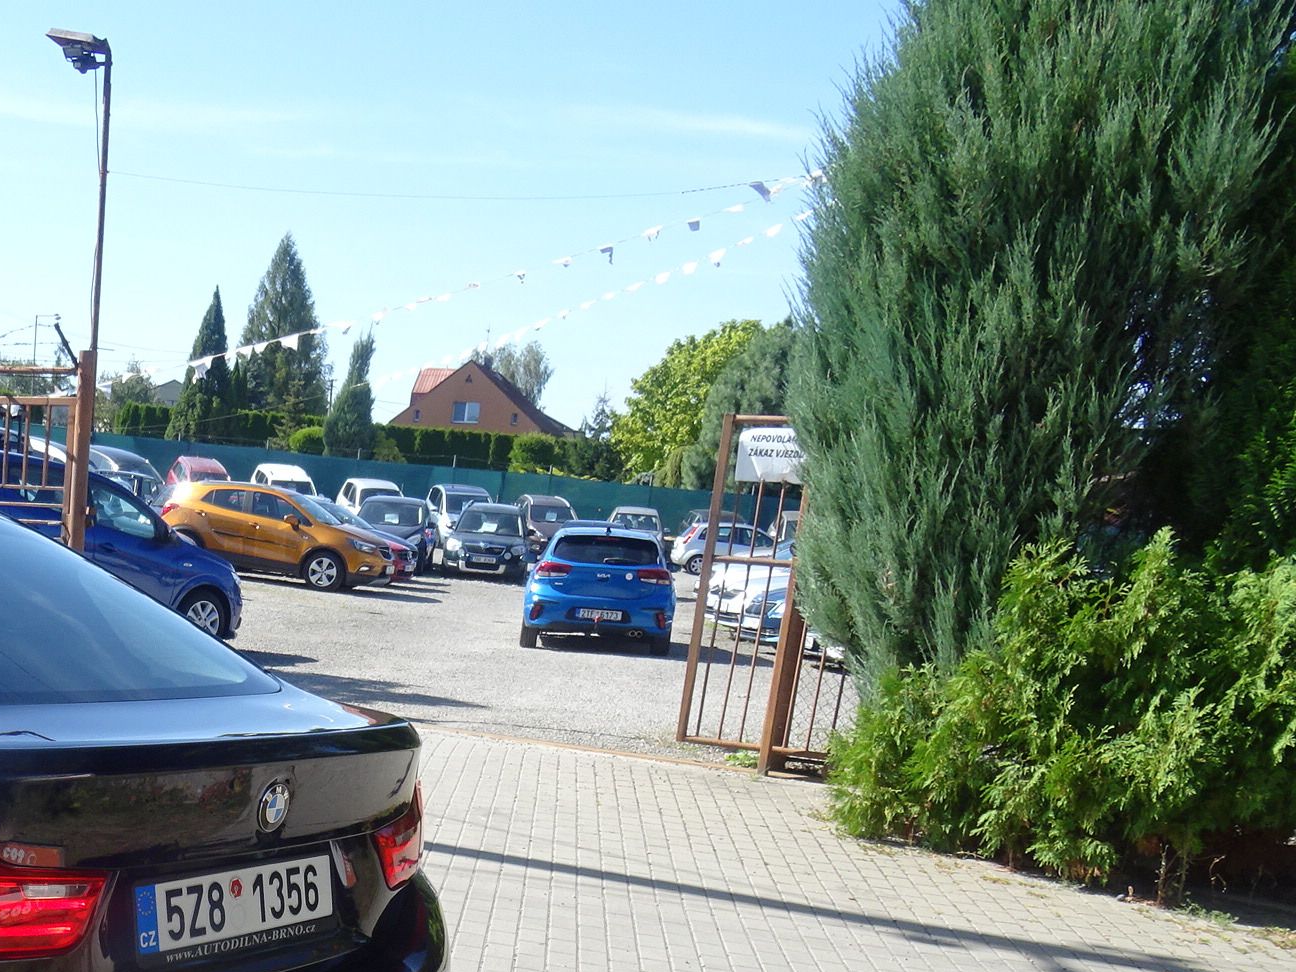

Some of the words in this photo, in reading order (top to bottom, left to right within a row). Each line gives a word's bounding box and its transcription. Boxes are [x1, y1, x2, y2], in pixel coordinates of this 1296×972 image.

[748, 446, 774, 458] ZÁKAZ
[266, 786, 289, 802] BMW
[165, 881, 226, 941] 5Z8
[252, 864, 320, 923] 1356
[139, 931, 157, 948] CZ
[166, 923, 316, 963] www.AUTODILNA-BRNO.cz
